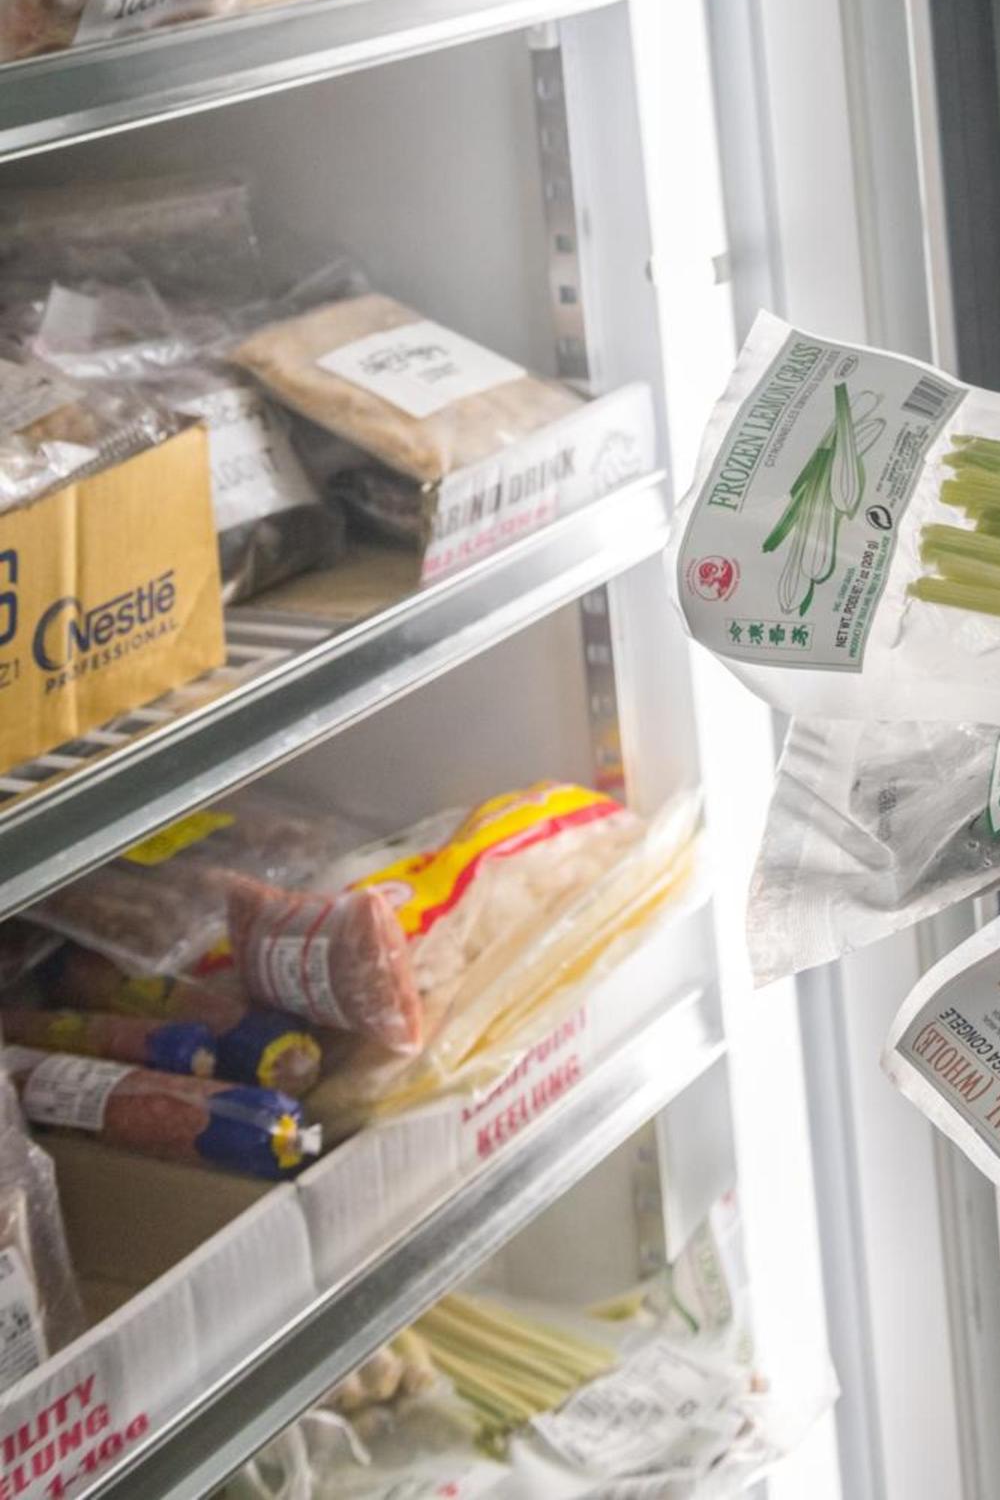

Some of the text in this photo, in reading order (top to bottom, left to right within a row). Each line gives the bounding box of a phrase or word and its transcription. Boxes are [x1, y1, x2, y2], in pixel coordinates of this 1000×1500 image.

[707, 426, 769, 511] FROZEN
[745, 383, 797, 433] LEMON
[774, 341, 824, 387] GRASS
[32, 569, 176, 672] Nestlé
[836, 630, 848, 647] NET
[476, 1052, 581, 1160] KEELUNG
[909, 1020, 994, 1107] (WHOLE)
